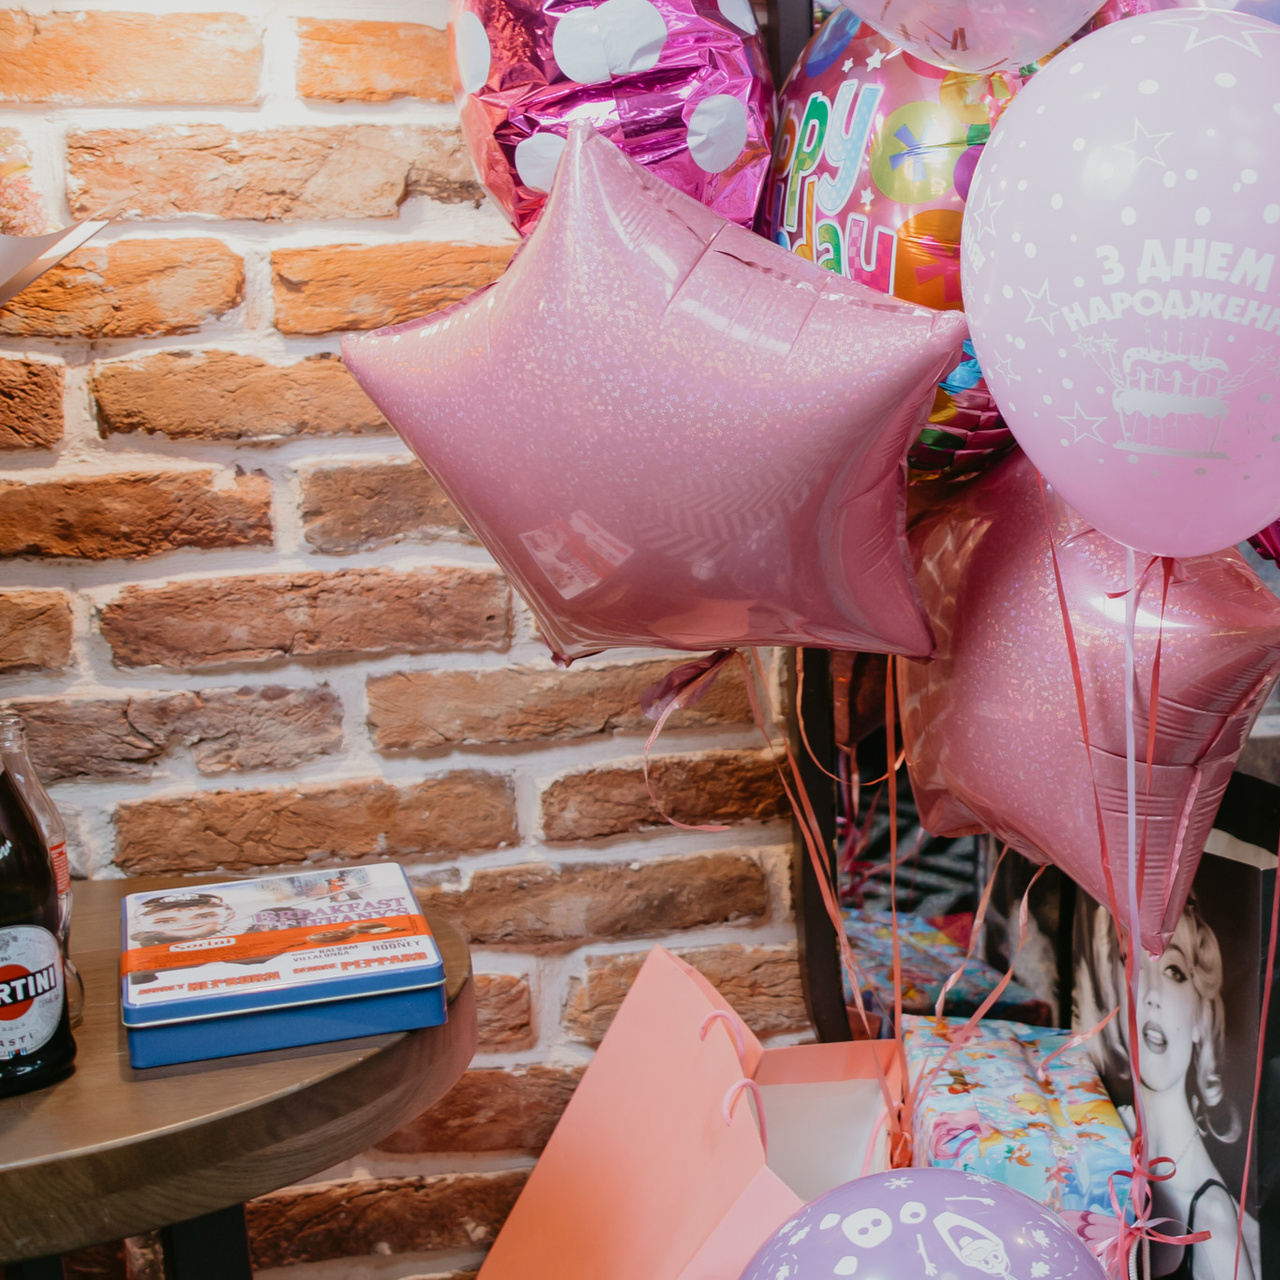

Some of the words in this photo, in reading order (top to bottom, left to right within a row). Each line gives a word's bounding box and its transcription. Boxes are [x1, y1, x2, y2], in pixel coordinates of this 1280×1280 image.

[1095, 244, 1125, 286] З
[1137, 237, 1276, 293] ДНЕМ
[252, 897, 406, 923] BREAKFAST
